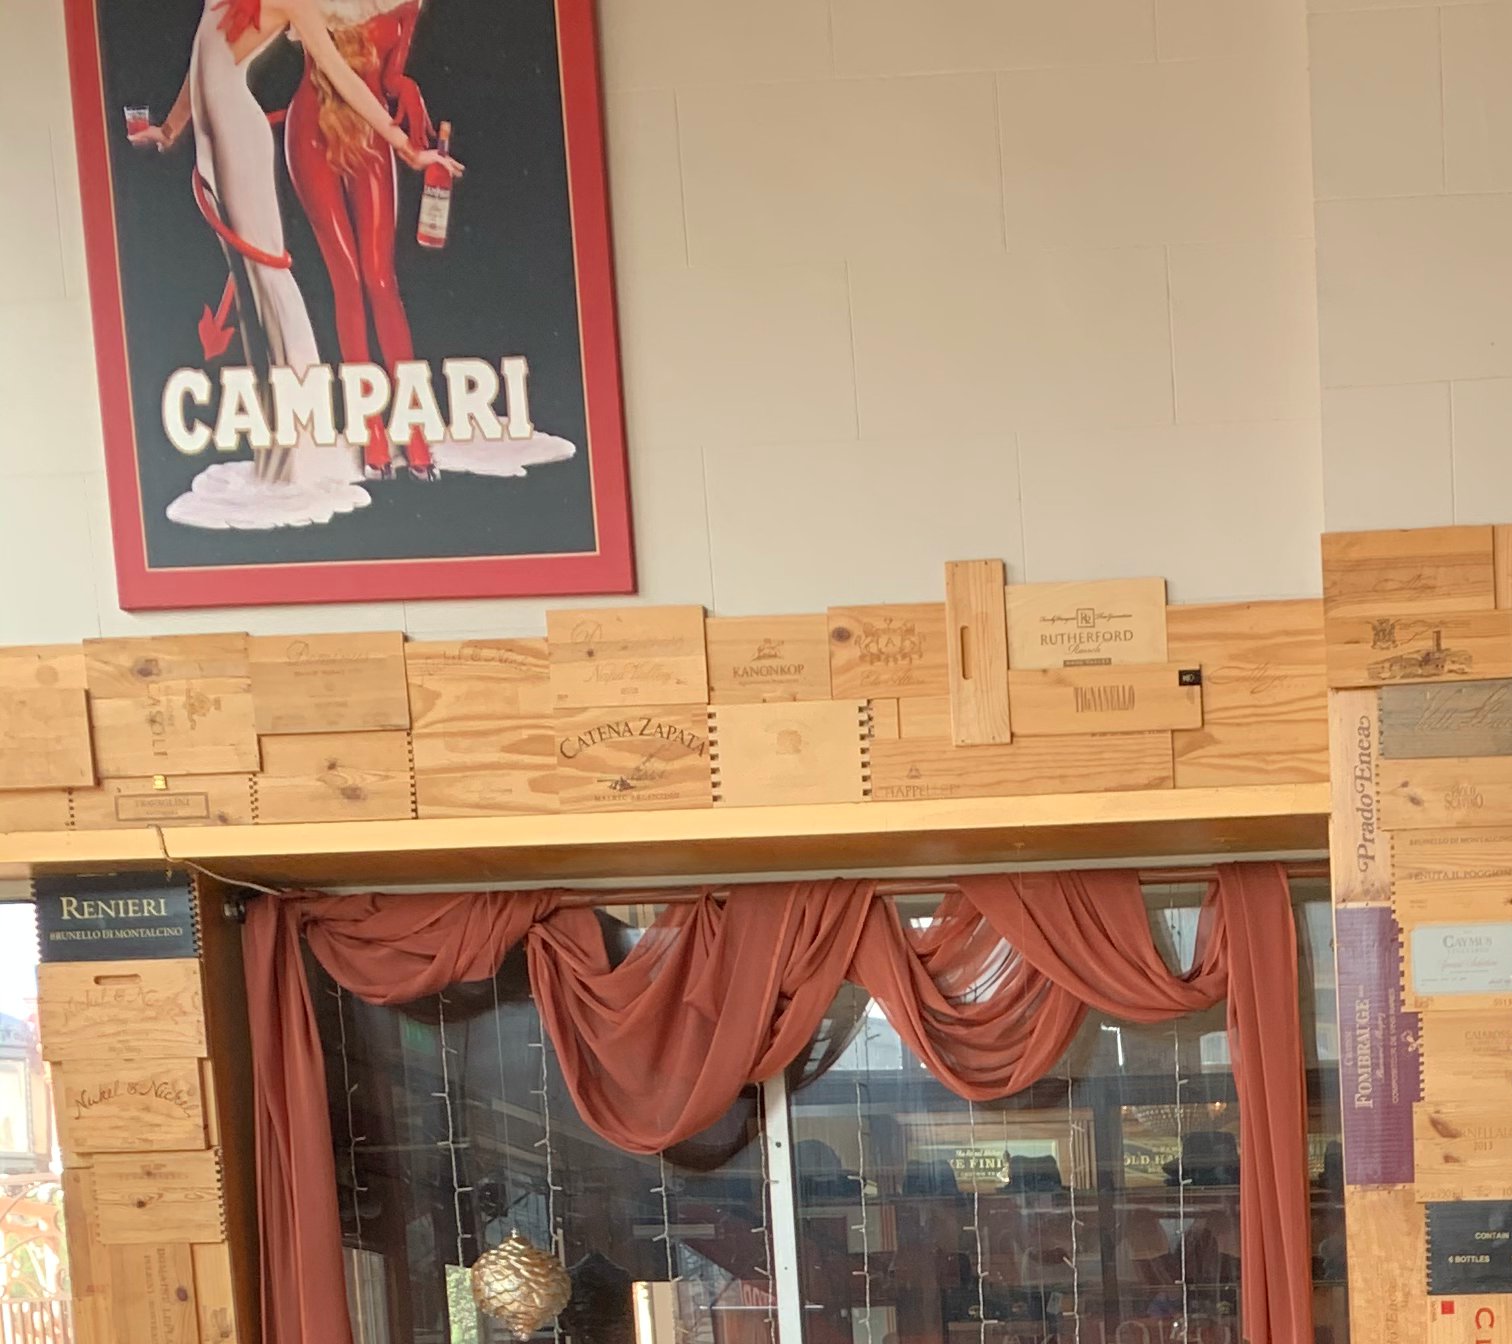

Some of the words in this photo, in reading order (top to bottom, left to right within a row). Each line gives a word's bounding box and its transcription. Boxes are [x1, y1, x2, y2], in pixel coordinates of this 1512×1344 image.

[161, 356, 535, 454] CAMPARI
[1040, 629, 1134, 646] RUTHERFORD
[732, 663, 804, 678] KANONKOP
[559, 718, 633, 759] CATENA
[638, 716, 707, 758] ZAPATA
[1353, 715, 1373, 794] Enea
[1355, 793, 1375, 873] Prado
[60, 896, 168, 921] RENIERI
[49, 929, 101, 942] BRUNELLO
[102, 929, 114, 939] DI
[115, 926, 184, 939] MONTALCINO
[1442, 935, 1493, 949] CAYMUS
[1355, 998, 1375, 1109] FOMBRAUGE
[1474, 1231, 1510, 1240] CONTAIN
[1455, 1255, 1490, 1264] BOTTLES
